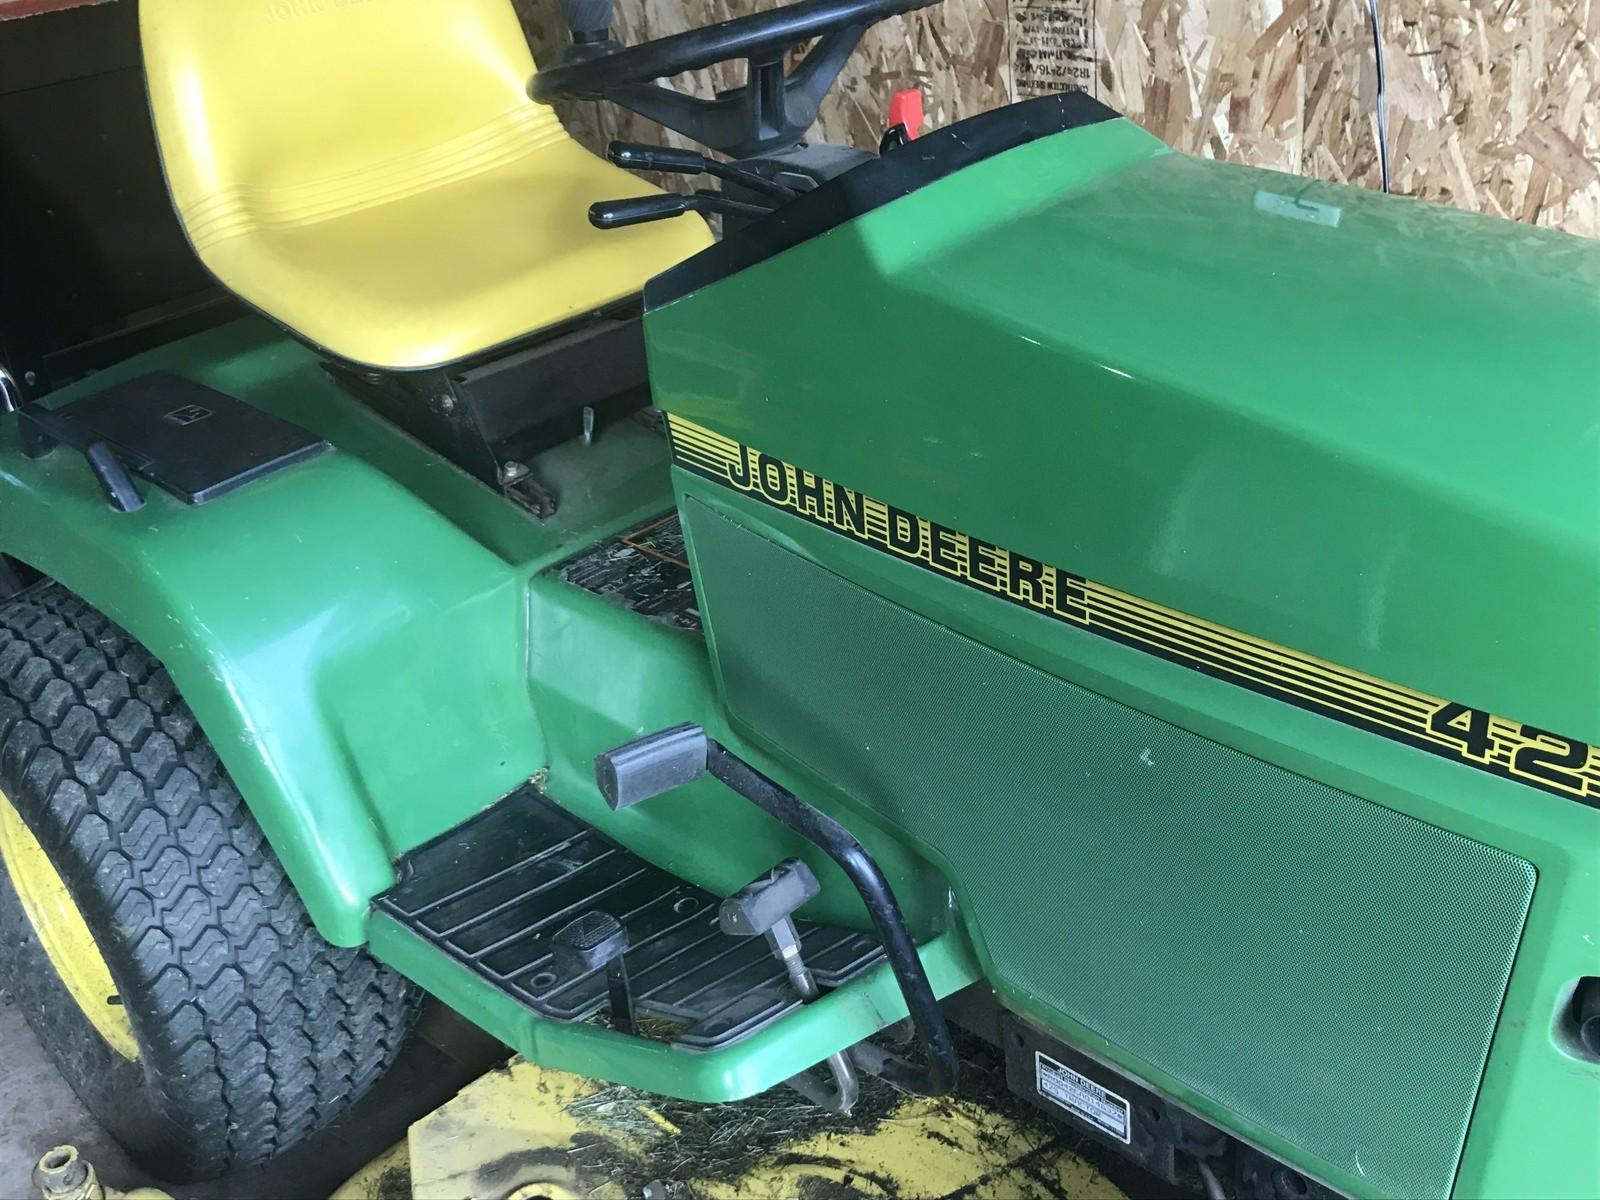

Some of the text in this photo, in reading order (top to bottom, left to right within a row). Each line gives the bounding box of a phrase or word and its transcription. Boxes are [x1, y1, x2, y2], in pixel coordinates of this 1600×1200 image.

[727, 442, 1091, 625] JOHN DEERE
[1057, 1067, 1105, 1098] JOHN DEERE
